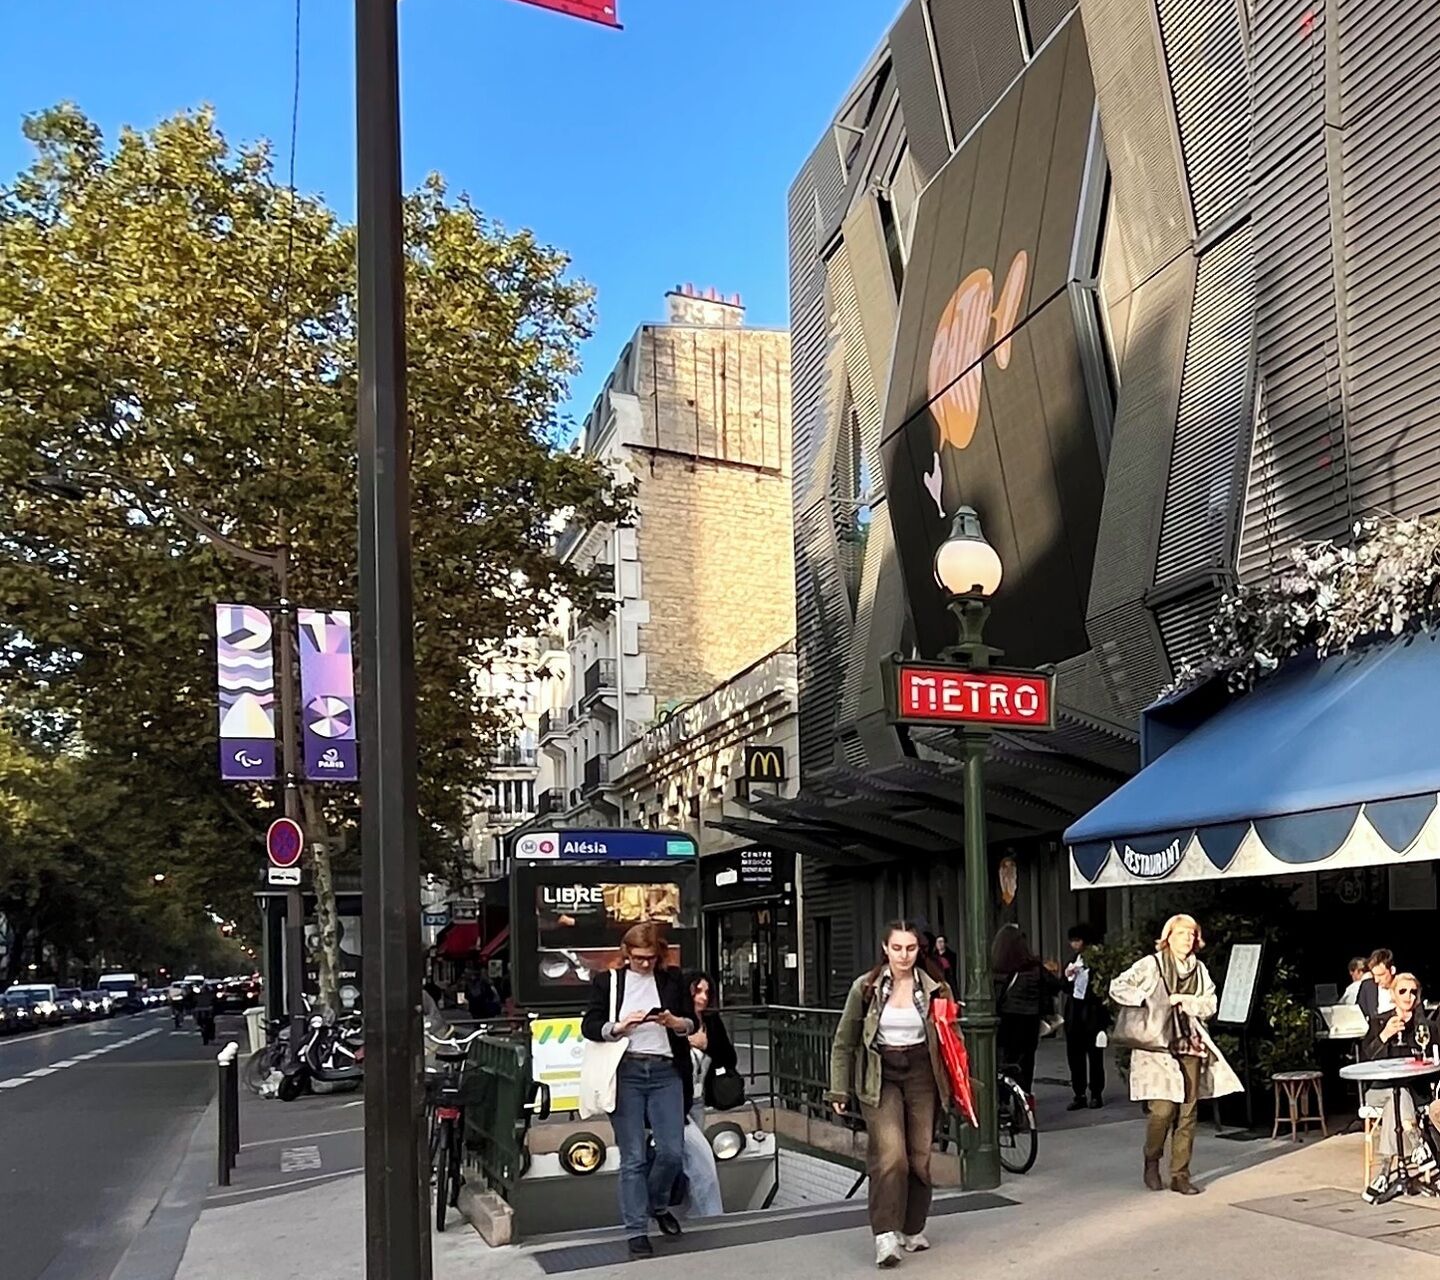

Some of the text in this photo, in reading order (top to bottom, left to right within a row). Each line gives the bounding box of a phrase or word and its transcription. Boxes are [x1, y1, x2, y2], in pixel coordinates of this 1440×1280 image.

[910, 675, 1039, 717] METRO
[563, 840, 608, 854] Alésia
[1123, 837, 1180, 875] RESTAURANT
[543, 886, 604, 904] LIBRE
